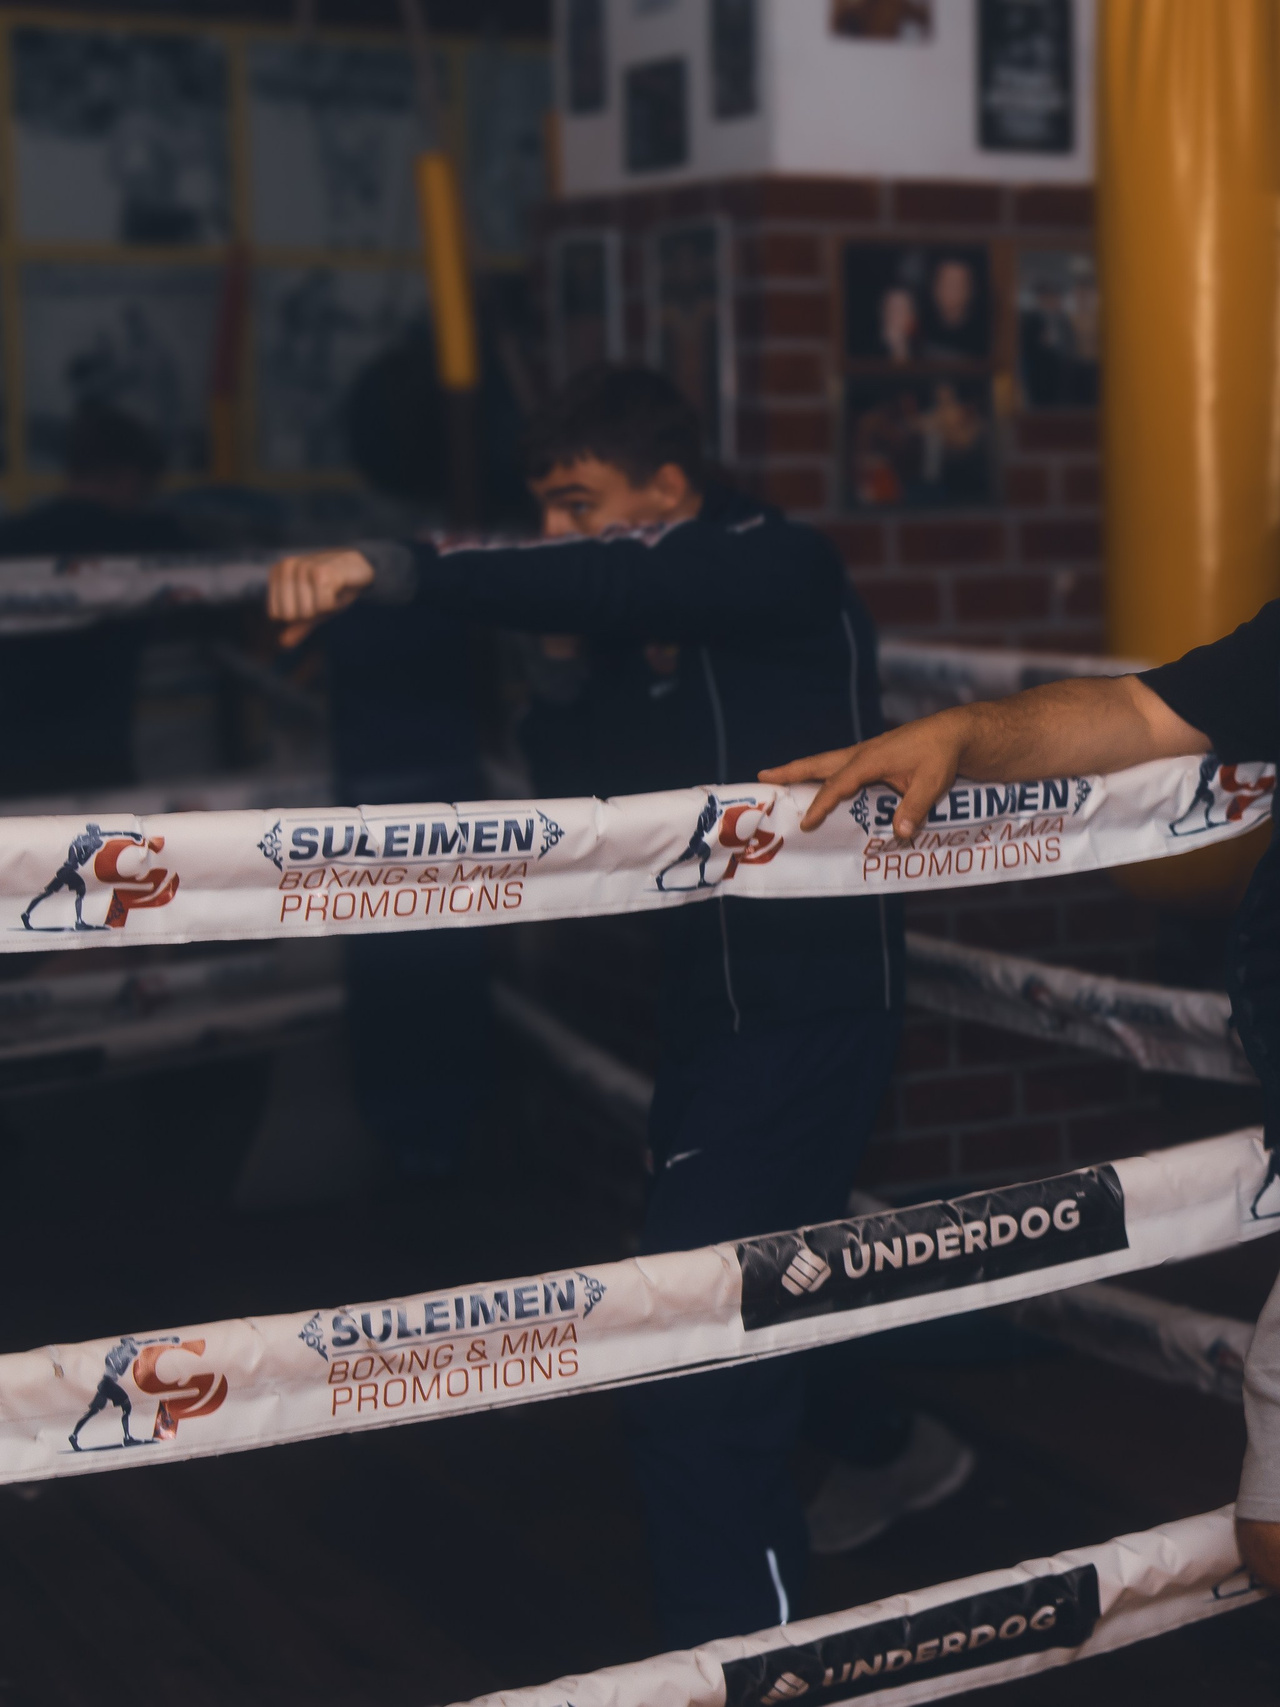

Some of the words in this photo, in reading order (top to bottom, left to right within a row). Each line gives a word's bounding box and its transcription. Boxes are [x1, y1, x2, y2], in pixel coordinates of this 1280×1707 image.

[874, 778, 1070, 827] SLEIMEN
[289, 818, 535, 860] SULEIMEN
[863, 836, 1061, 881] PROMOTIONS
[278, 867, 408, 891] BOXING
[417, 867, 440, 884] &
[451, 861, 528, 883] MMA
[280, 881, 524, 922] PROMOTIONS
[842, 1199, 1081, 1279] UNDERDOG
[331, 1279, 576, 1348] SULEIMEN
[328, 1343, 454, 1384] BOXING
[466, 1339, 488, 1362] &
[501, 1322, 578, 1357] MMA
[332, 1348, 579, 1416] PROMOTIONS
[823, 1604, 1056, 1687] UNDERDOG
